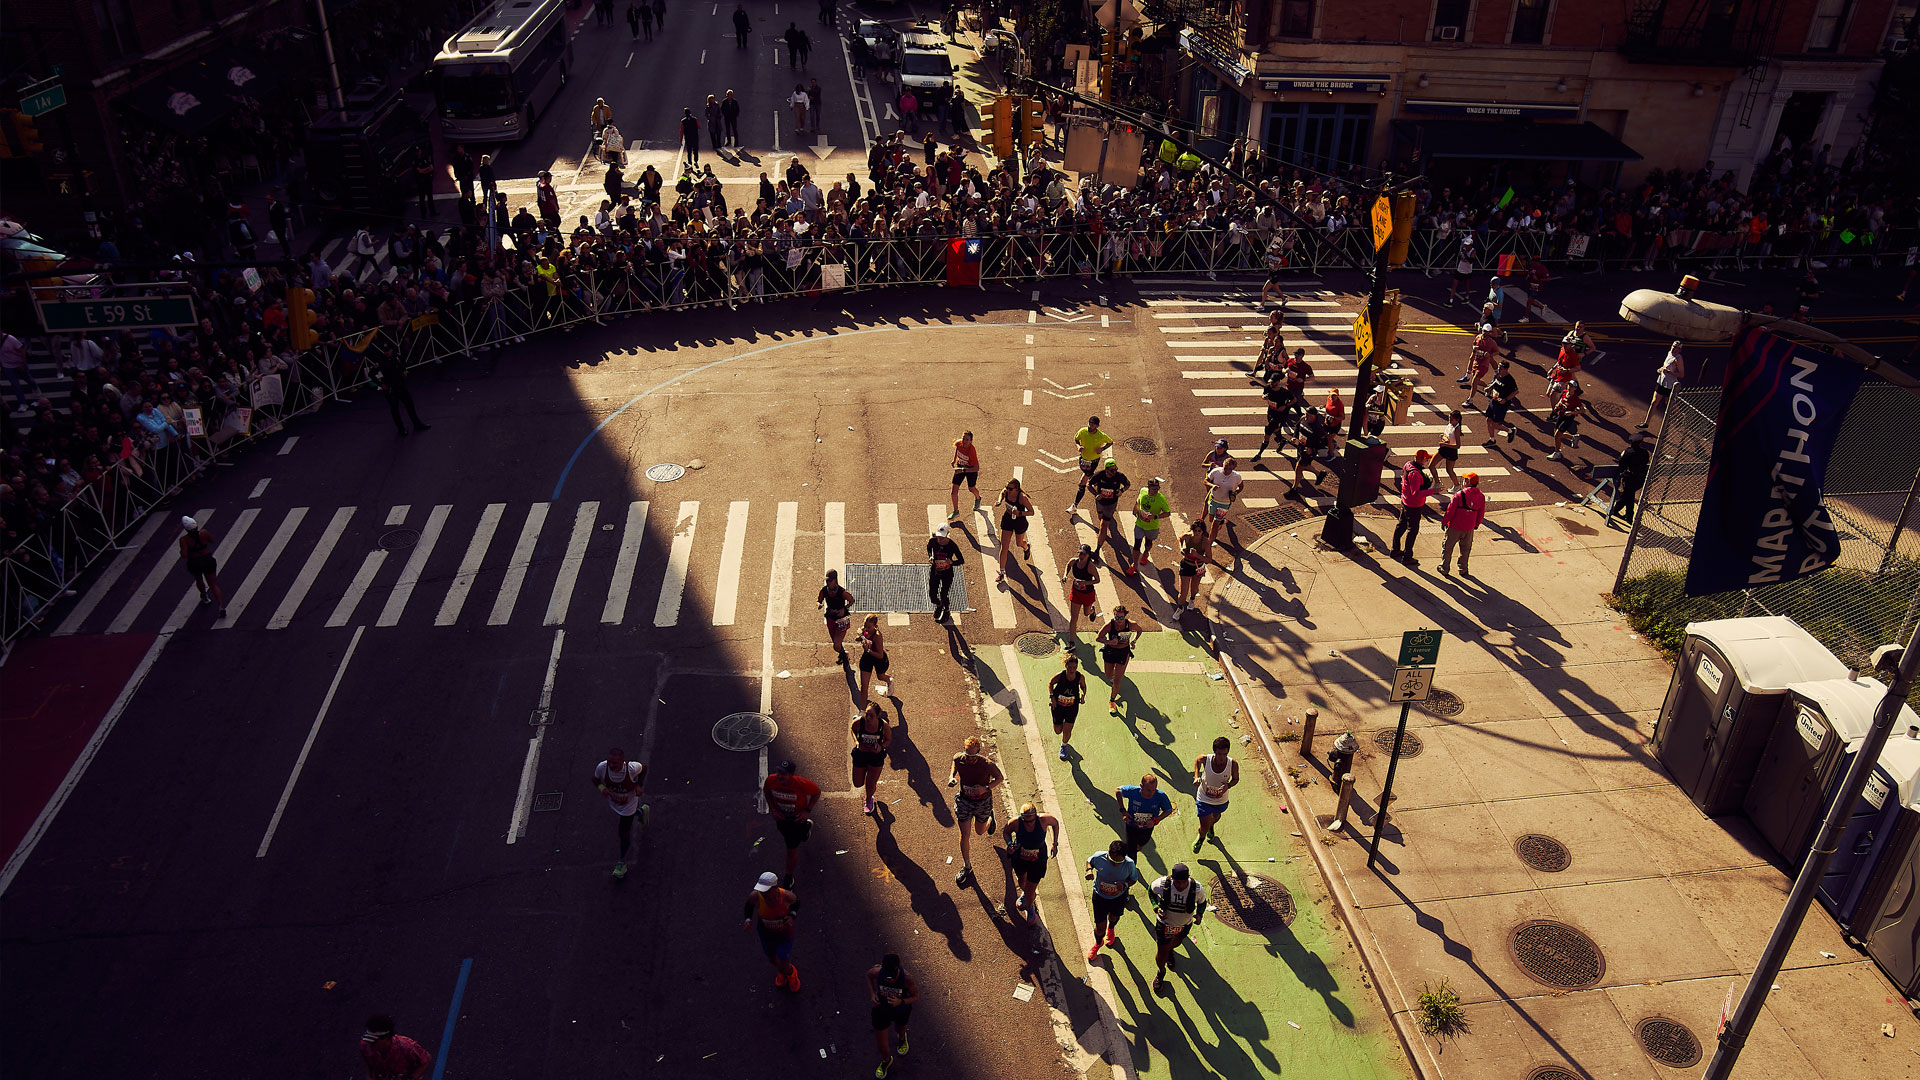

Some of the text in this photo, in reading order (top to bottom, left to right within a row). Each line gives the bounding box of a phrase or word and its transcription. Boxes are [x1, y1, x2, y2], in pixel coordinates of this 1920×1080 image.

[35, 95, 53, 111] 1 Av
[83, 304, 153, 324] E 59 St
[1747, 356, 1819, 585] MARATHON
[1702, 661, 1721, 684] United
[1800, 715, 1823, 741] United
[1866, 781, 1887, 801] nited
[1174, 893, 1185, 904] 14
